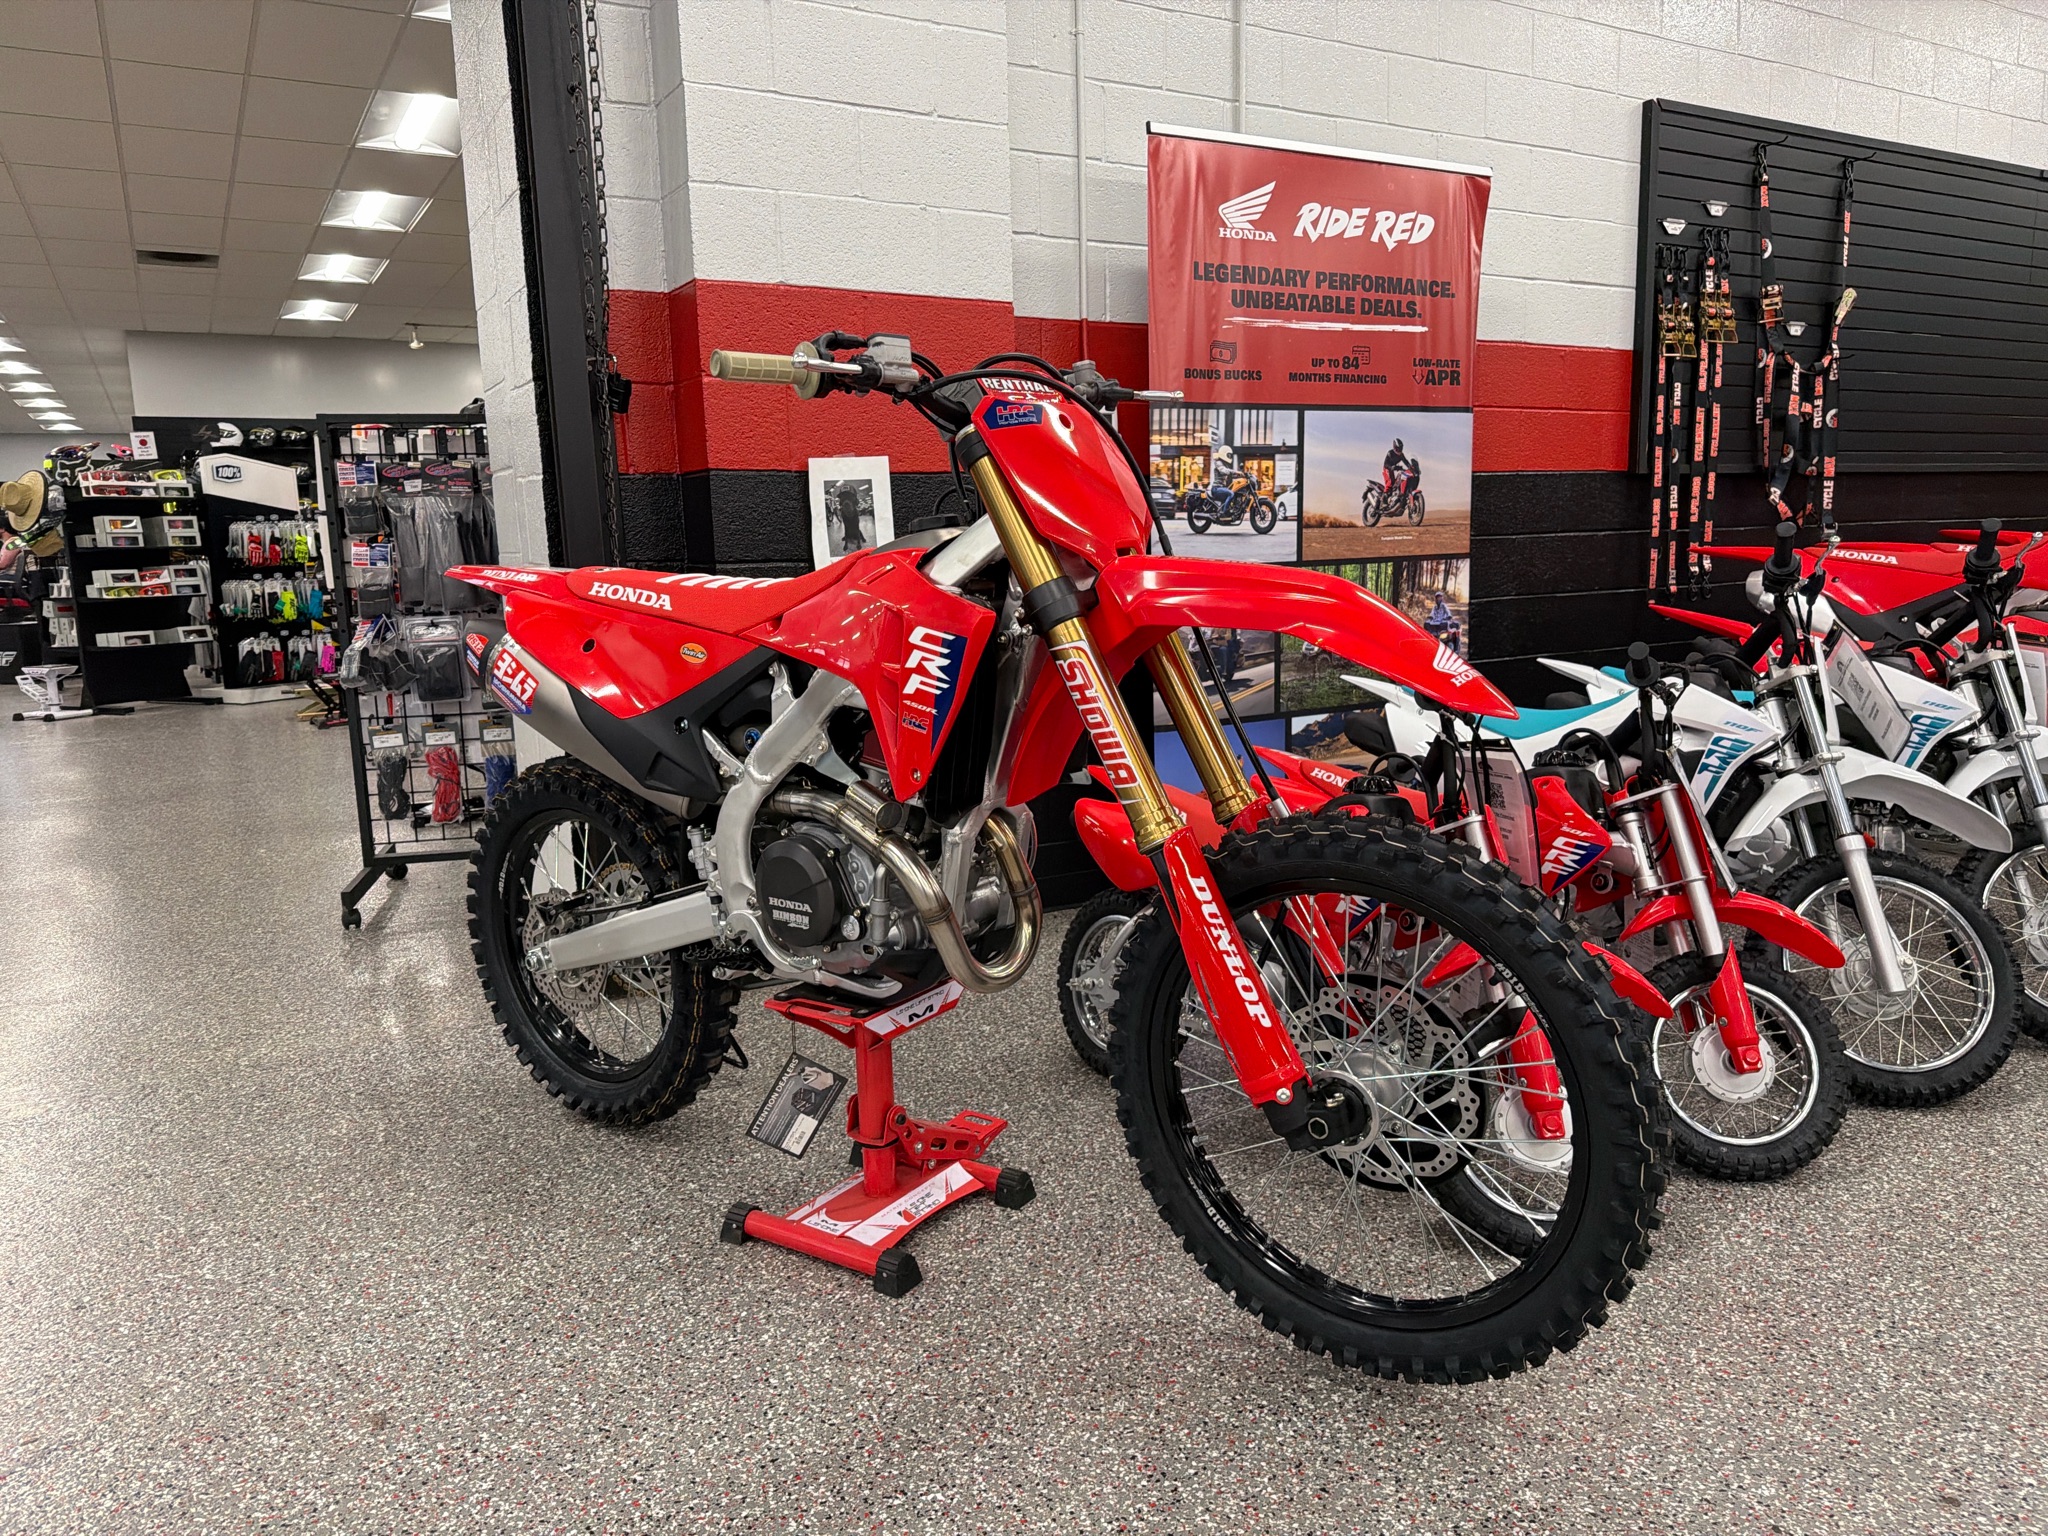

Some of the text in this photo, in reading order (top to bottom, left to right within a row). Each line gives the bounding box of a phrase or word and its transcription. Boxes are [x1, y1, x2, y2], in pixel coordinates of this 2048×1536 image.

[1218, 227, 1277, 242] HONDA
[1293, 202, 1435, 252] RIDE RED
[1193, 261, 1455, 298] LEGENDARY PERFORMANCE.
[1705, 269, 1714, 293] YCLE
[1231, 289, 1422, 319] UNBEATABLE DEALS.
[1311, 356, 1360, 371] UP TO 84
[1413, 358, 1461, 369] LOW-RATE
[1184, 368, 1262, 382] BONUS BUCKS
[1289, 372, 1387, 385] MONTHS FINANCING
[1424, 370, 1461, 386] APR
[1673, 382, 1682, 407] CYCLE
[1788, 361, 1800, 416] CYCLE MAX
[996, 404, 1036, 422] HRC
[1813, 399, 1823, 429] CYCLE
[217, 466, 241, 479] 100%
[1823, 456, 1836, 510] MAX CYCLE
[1669, 485, 1678, 509] CYCLE
[1830, 550, 1898, 565] HONDA
[588, 582, 673, 611] HONDA
[466, 633, 485, 654] RS12
[682, 646, 706, 660] Twin Air
[902, 626, 956, 695] CRF
[493, 651, 538, 703] ヨシムラ
[902, 700, 939, 716] 450R
[902, 712, 929, 730] HRC
[1056, 658, 1140, 788] SHOWA
[1309, 767, 1349, 788] HON
[1560, 826, 1597, 838] 50F
[1541, 836, 1591, 876] CRF
[768, 896, 813, 913] HONDA
[1188, 876, 1272, 1028] DUNLOP
[751, 1091, 779, 1136] ATTENTION
[776, 1058, 799, 1092] DEALERS
